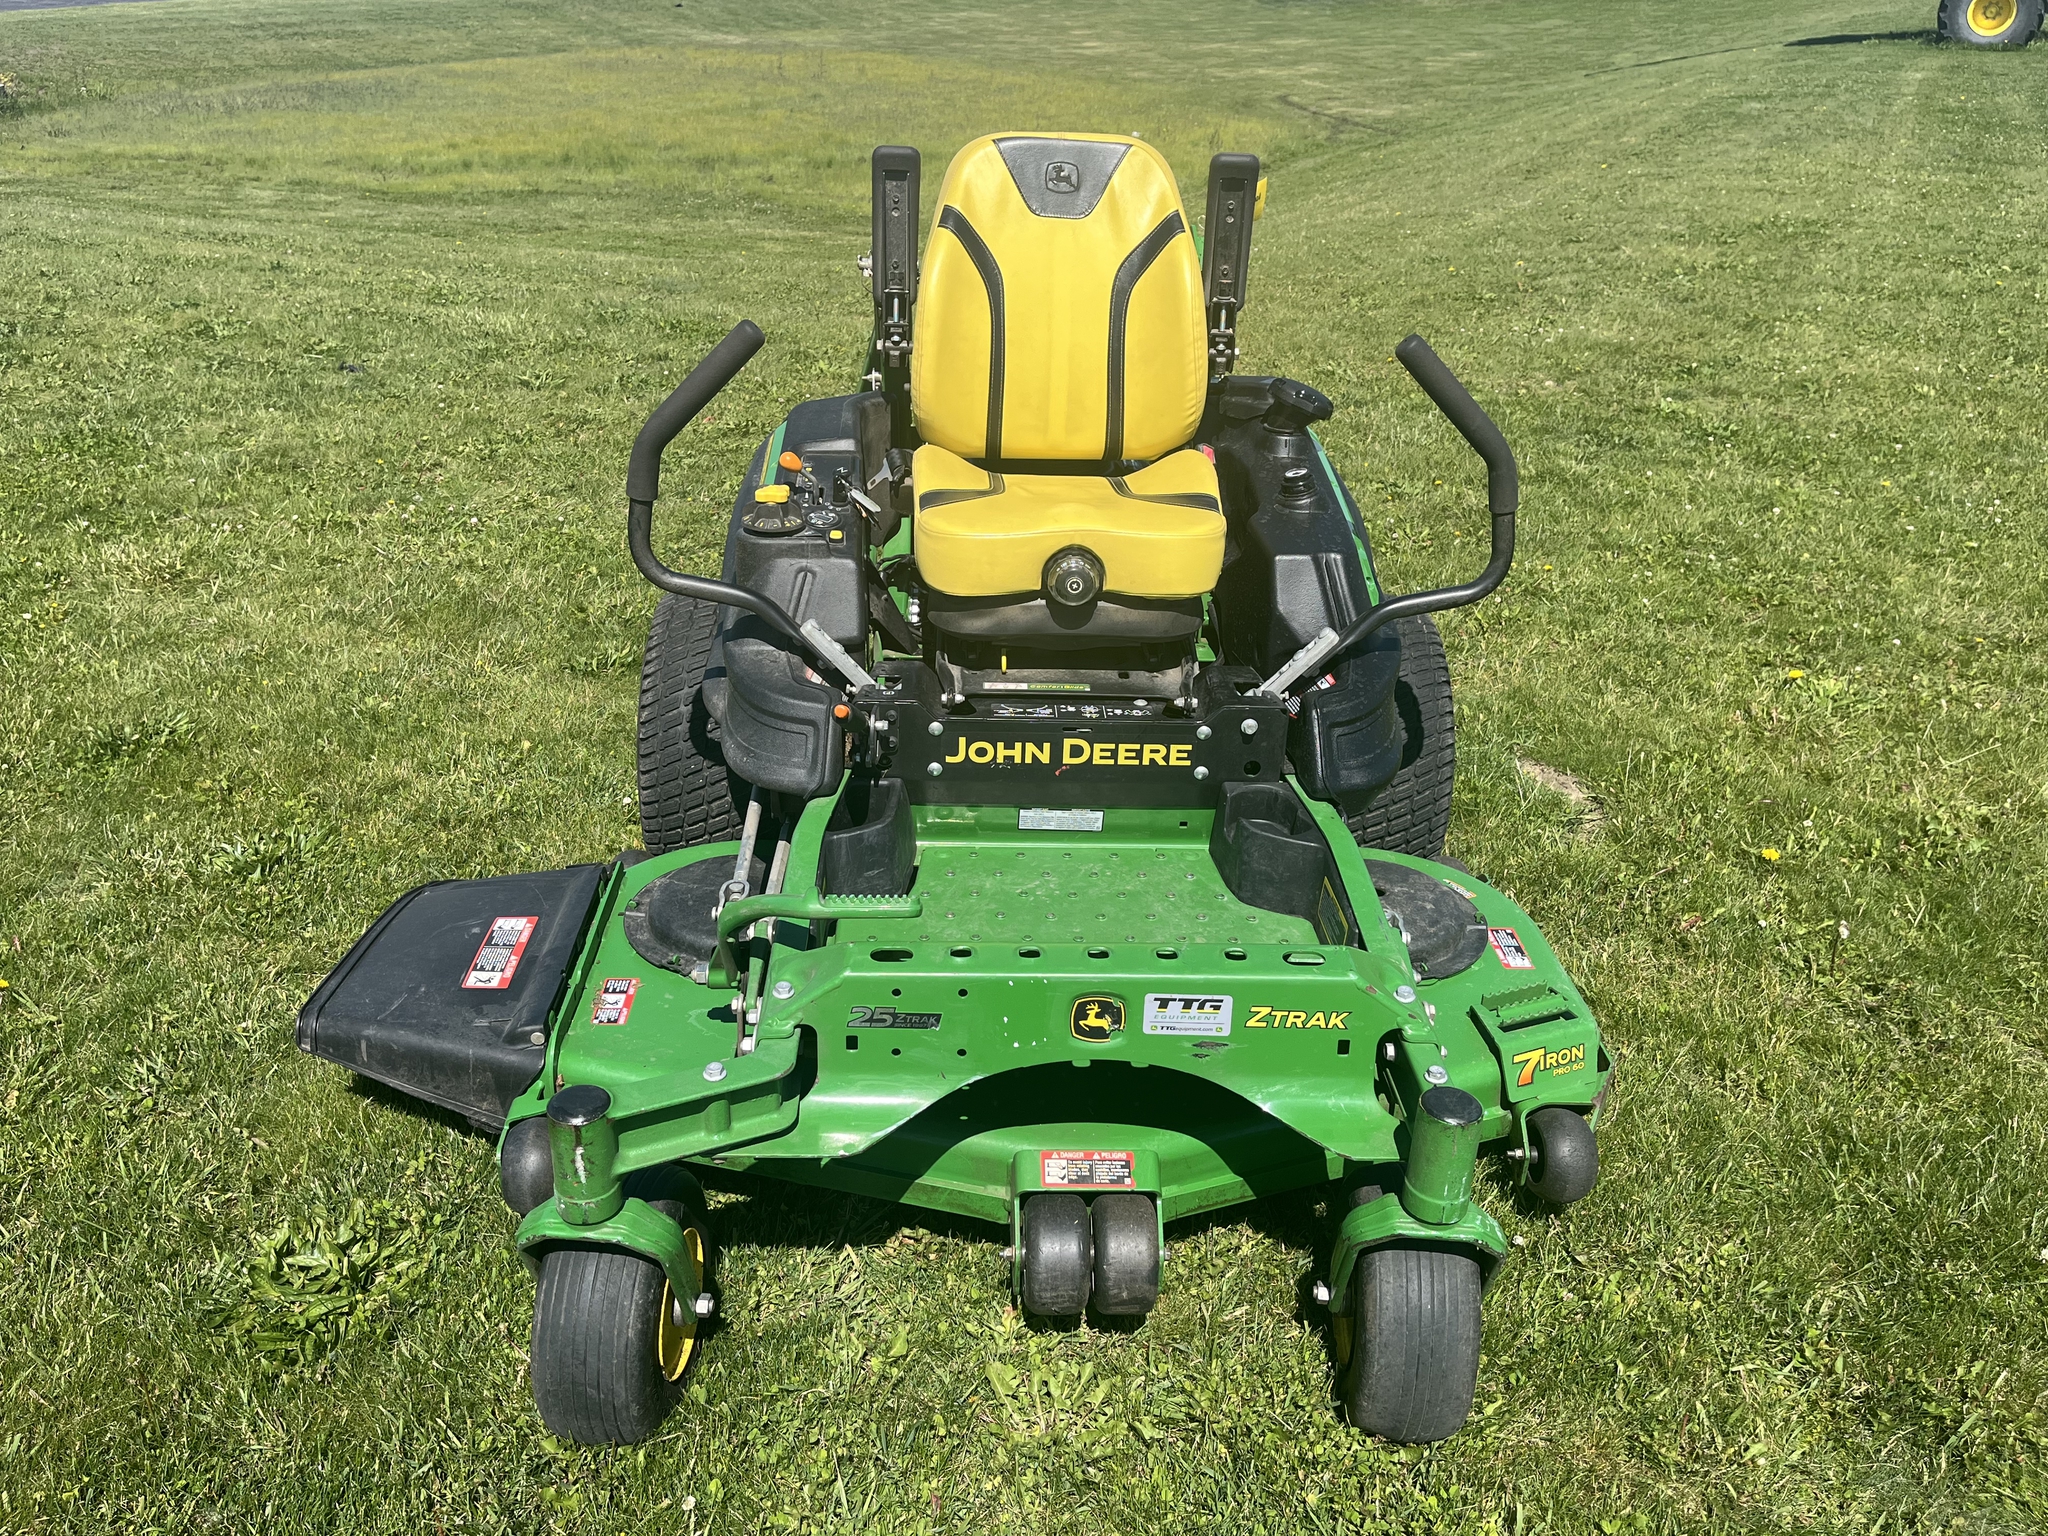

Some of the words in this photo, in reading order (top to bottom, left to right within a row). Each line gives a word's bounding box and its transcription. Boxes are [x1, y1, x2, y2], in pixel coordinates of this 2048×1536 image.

[945, 736, 1051, 764] JOHN
[1062, 738, 1193, 766] DEERE
[1153, 997, 1224, 1014] TTG
[847, 1006, 896, 1028] 25
[895, 1013, 938, 1024] ZTRAK
[1244, 1006, 1352, 1030] ZTRAK
[1553, 1065, 1571, 1077] PRO
[1572, 1061, 1585, 1071] 60
[1060, 1151, 1085, 1159] DANGER
